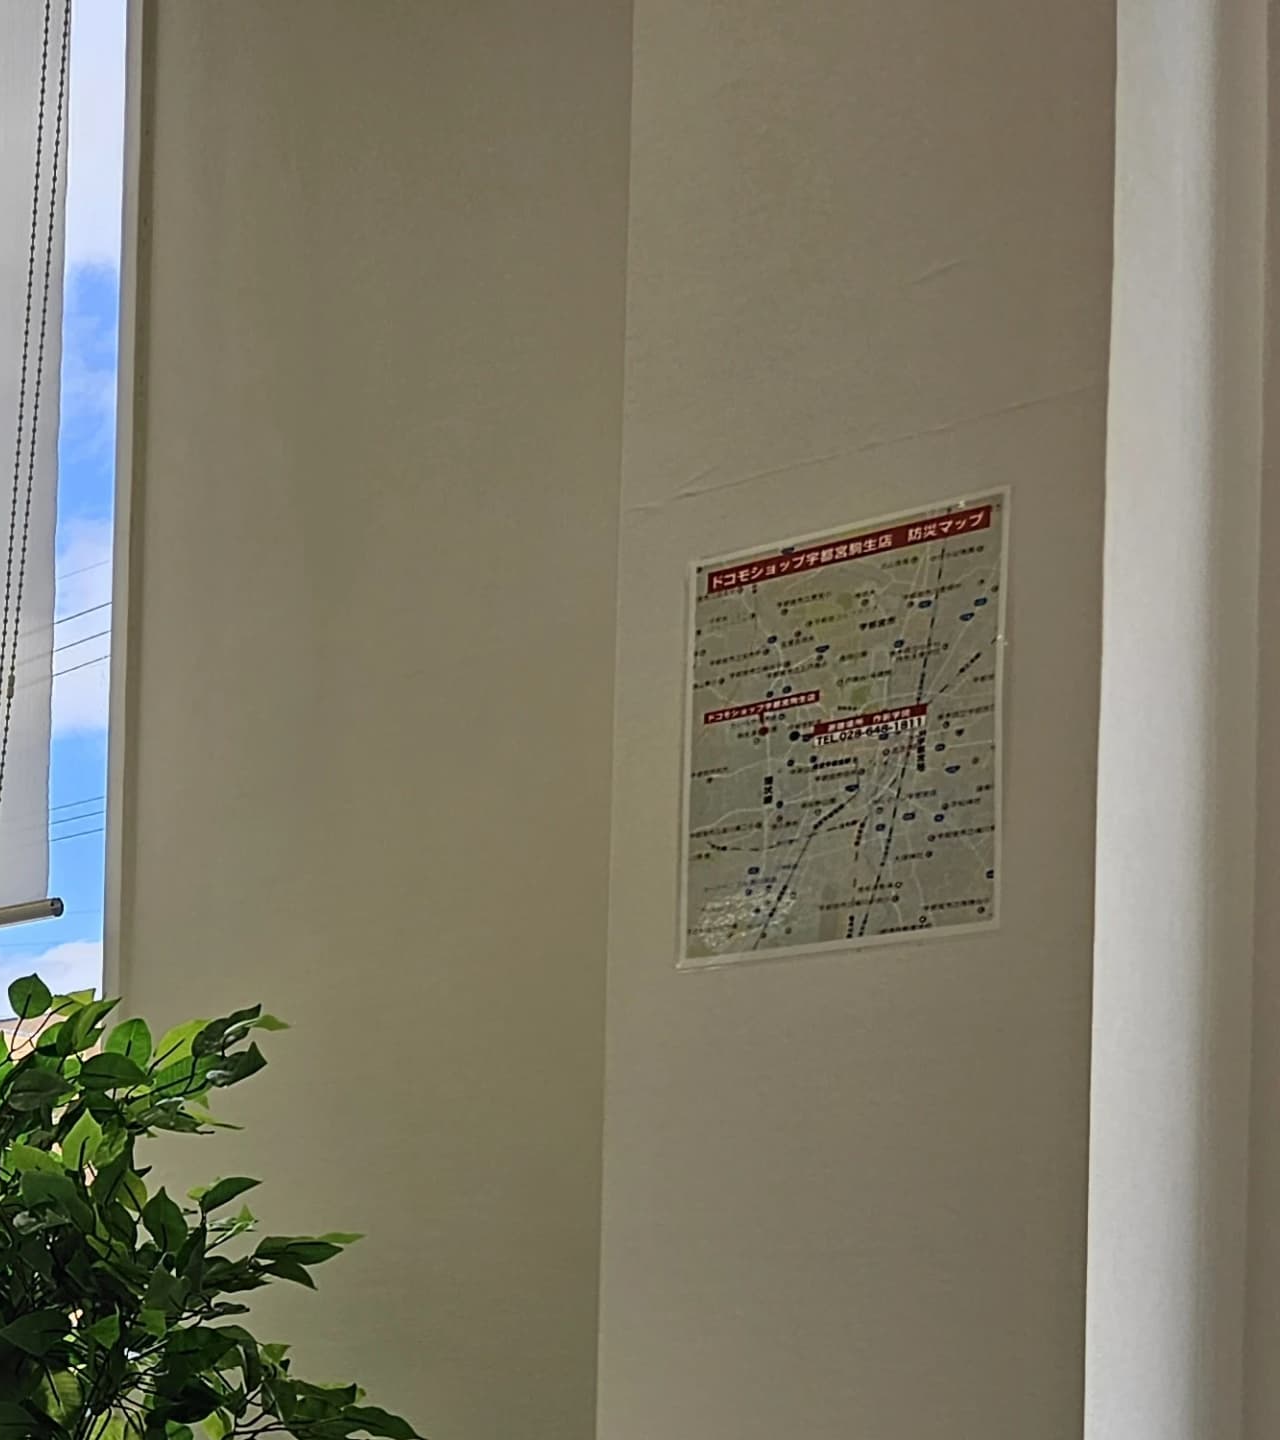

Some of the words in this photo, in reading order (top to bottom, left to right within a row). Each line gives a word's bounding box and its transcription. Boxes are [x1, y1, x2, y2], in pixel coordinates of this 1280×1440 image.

[906, 510, 986, 543] 防災マップ
